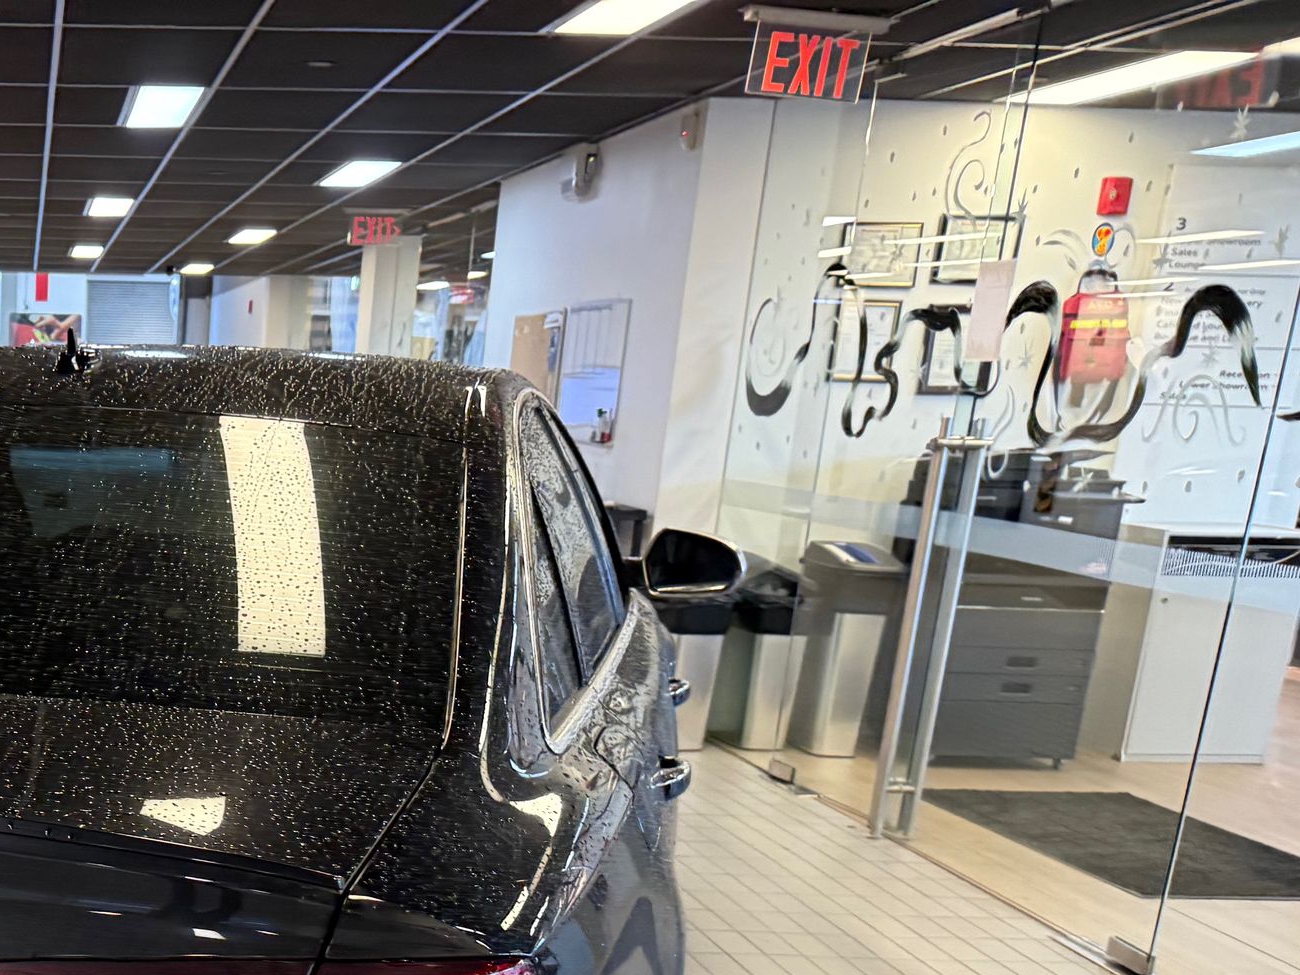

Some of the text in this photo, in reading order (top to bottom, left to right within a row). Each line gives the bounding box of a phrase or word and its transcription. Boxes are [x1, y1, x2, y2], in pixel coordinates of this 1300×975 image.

[761, 31, 860, 99] EXIT
[352, 216, 397, 245] EXIT
[1176, 217, 1187, 230] 3
[1171, 247, 1198, 257] Sales
